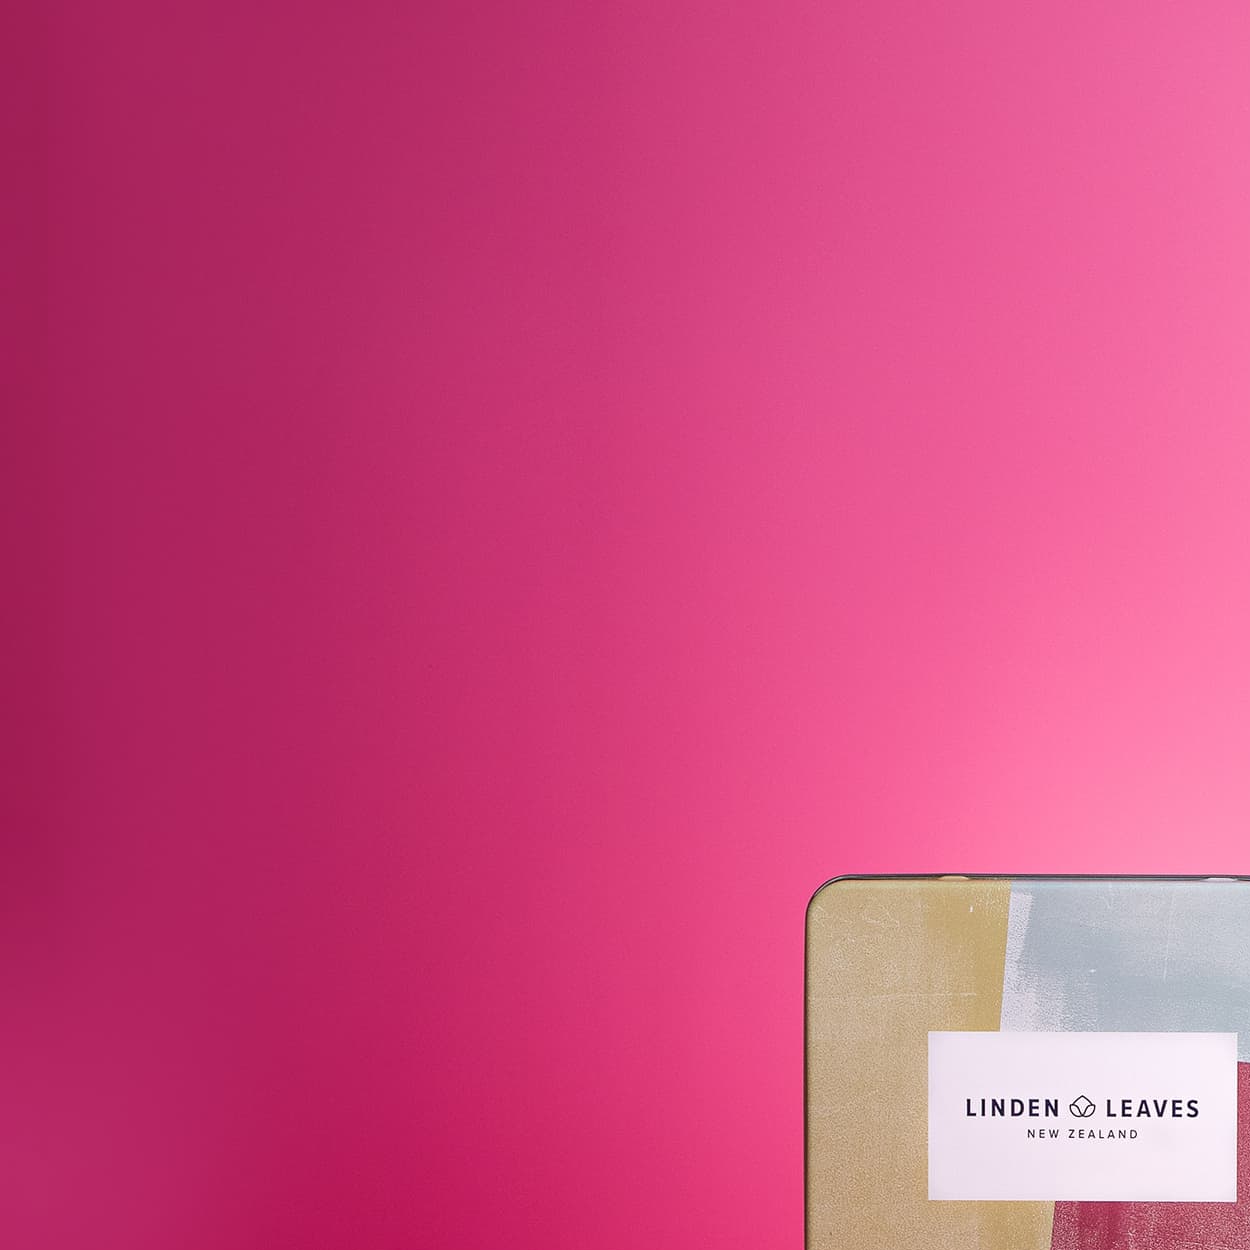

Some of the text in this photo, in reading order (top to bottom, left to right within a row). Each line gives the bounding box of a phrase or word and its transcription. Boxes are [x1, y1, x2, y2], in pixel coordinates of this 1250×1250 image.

[966, 1098, 1199, 1118] LINDEN LEAVES
[1027, 1129, 1138, 1139] NEW ZEALAND
